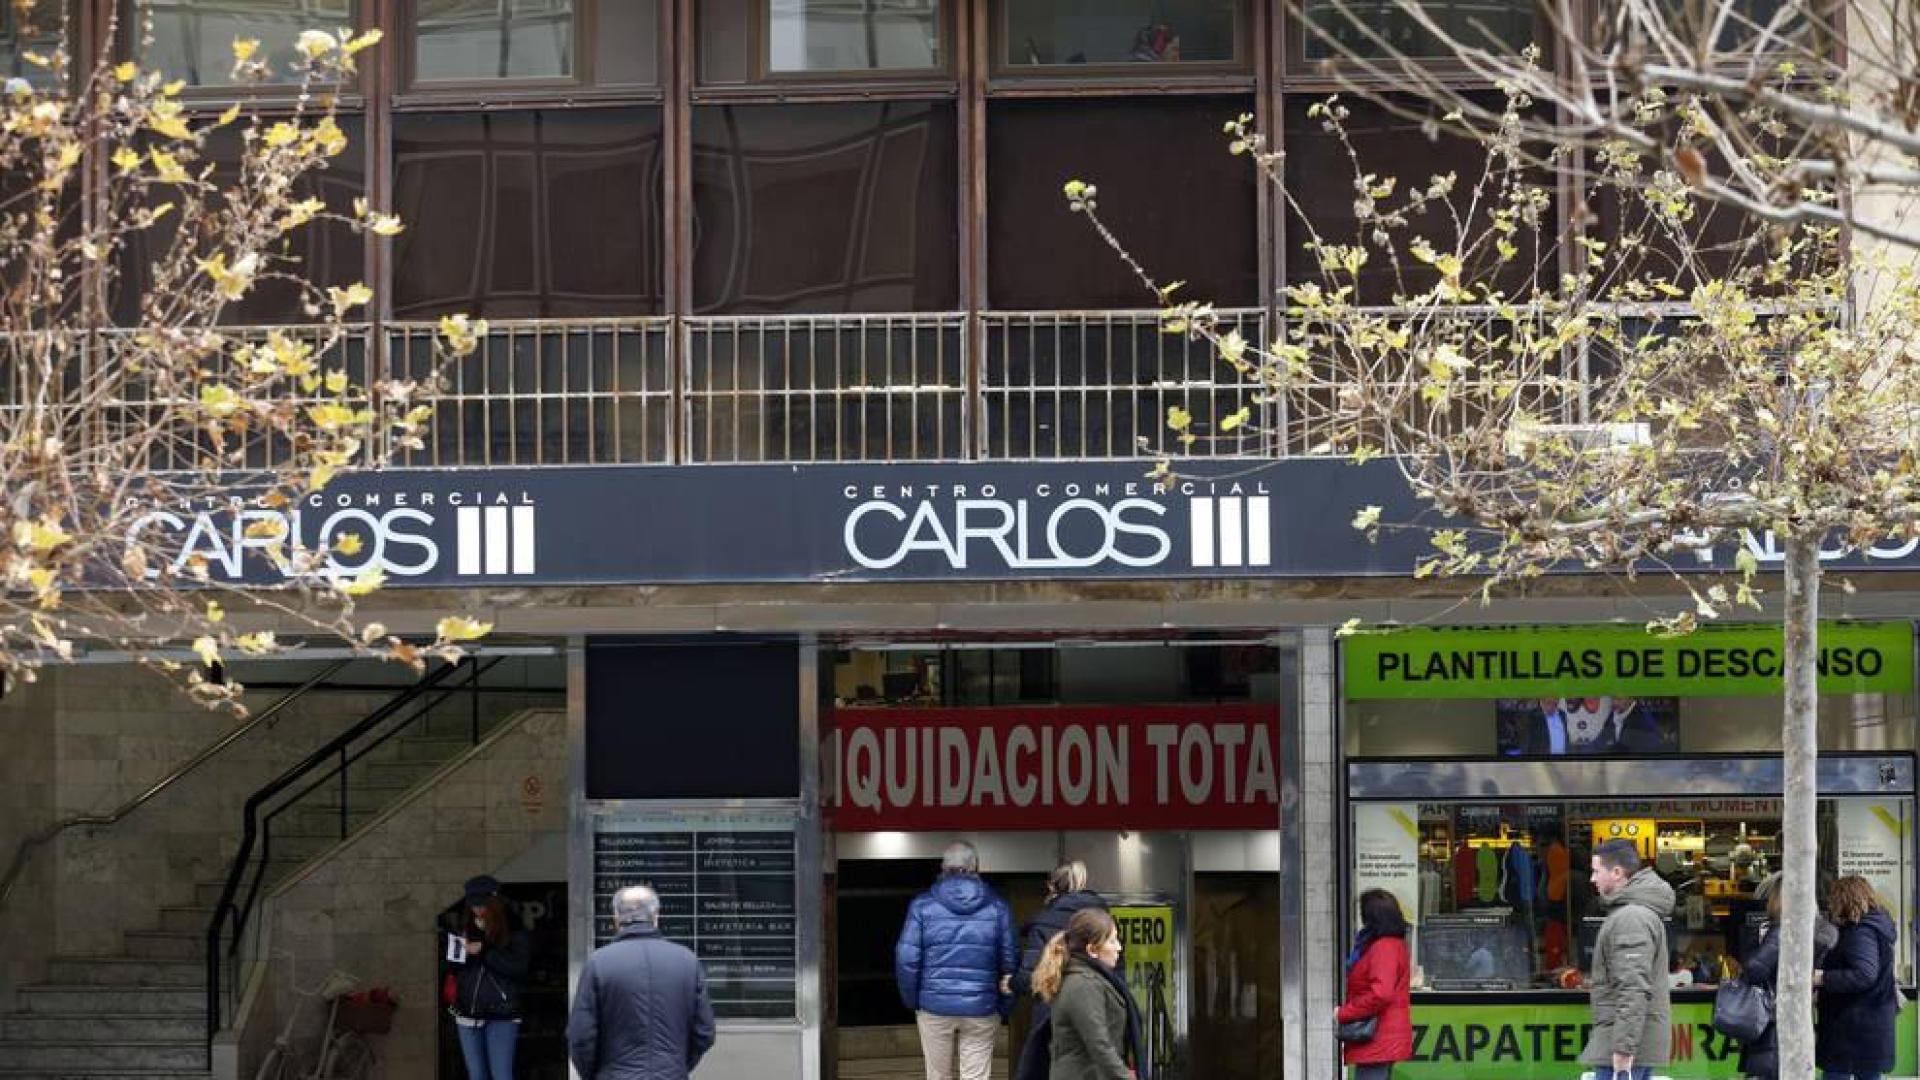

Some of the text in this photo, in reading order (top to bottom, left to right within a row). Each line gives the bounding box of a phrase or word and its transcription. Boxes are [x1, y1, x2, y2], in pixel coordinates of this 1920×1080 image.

[310, 491, 535, 508] COMERCIAL
[844, 482, 1270, 499] CENTRO COMERCIAL
[125, 508, 440, 577] CARLOS
[844, 498, 1172, 569] CARLOS
[1377, 647, 1882, 681] PLANTILLAS DE DESCNSO
[835, 722, 1278, 813] IQUIDACION TOTA
[1690, 798, 1783, 814] MOMENT
[1117, 917, 1165, 945] TERO
[1411, 1023, 1584, 1062] ZAPATE
